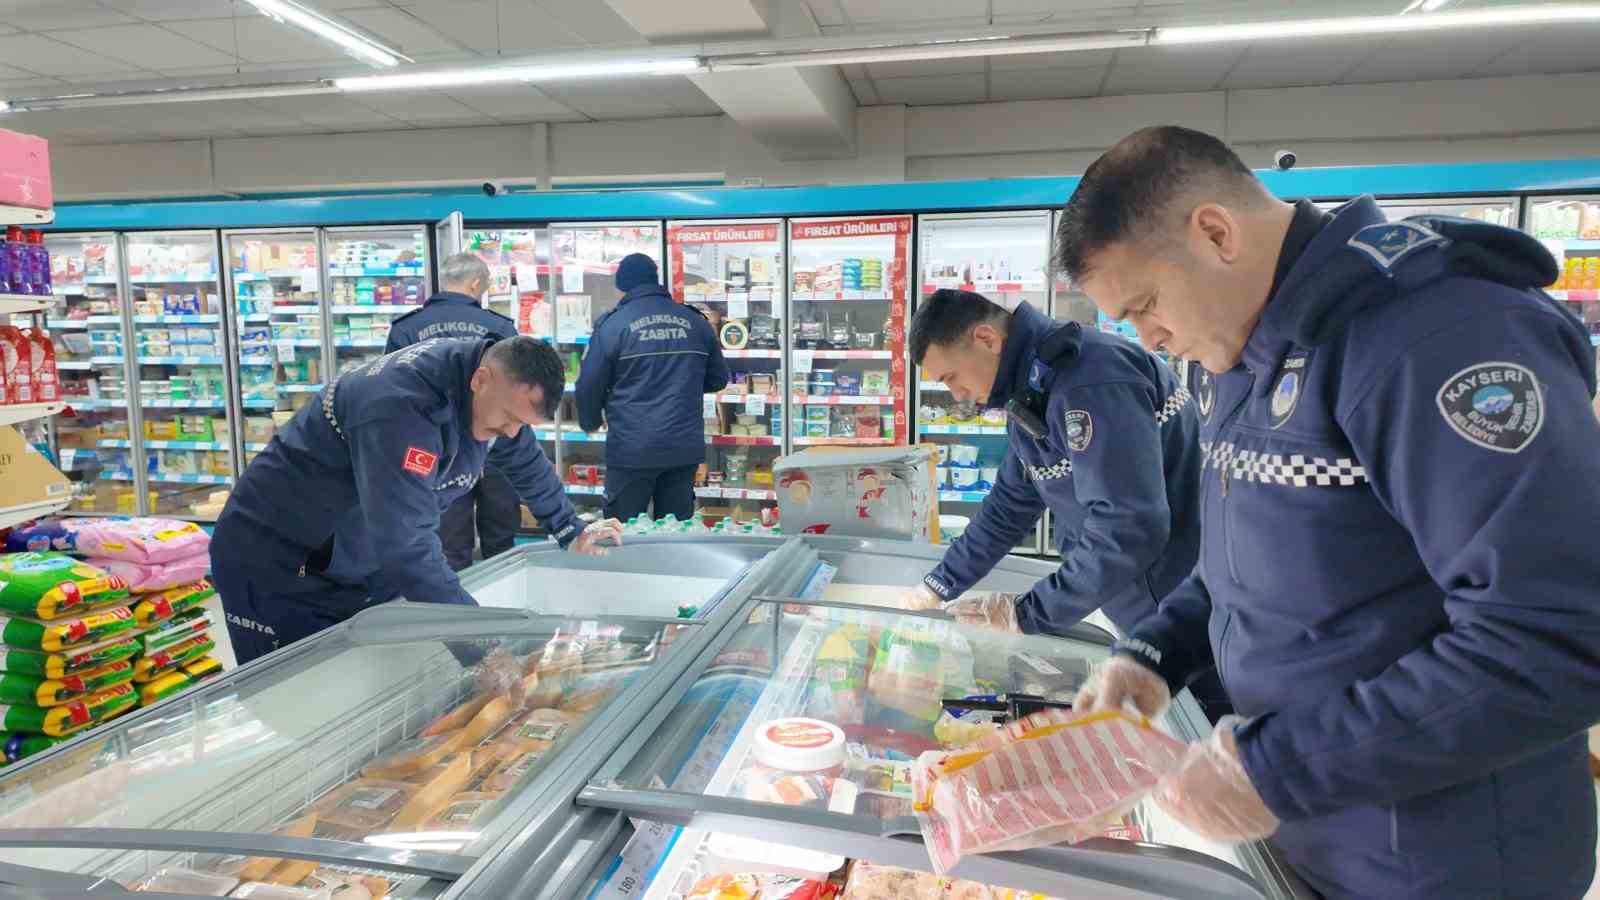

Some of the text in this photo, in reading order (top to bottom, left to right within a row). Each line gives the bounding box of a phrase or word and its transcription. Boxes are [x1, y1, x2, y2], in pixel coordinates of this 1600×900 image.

[675, 231, 711, 242] FIRSAT
[804, 225, 842, 237] FIRSAT
[639, 327, 688, 341] ZABITA
[1444, 369, 1524, 402] KAYSERI
[226, 612, 276, 635] ZABITA
